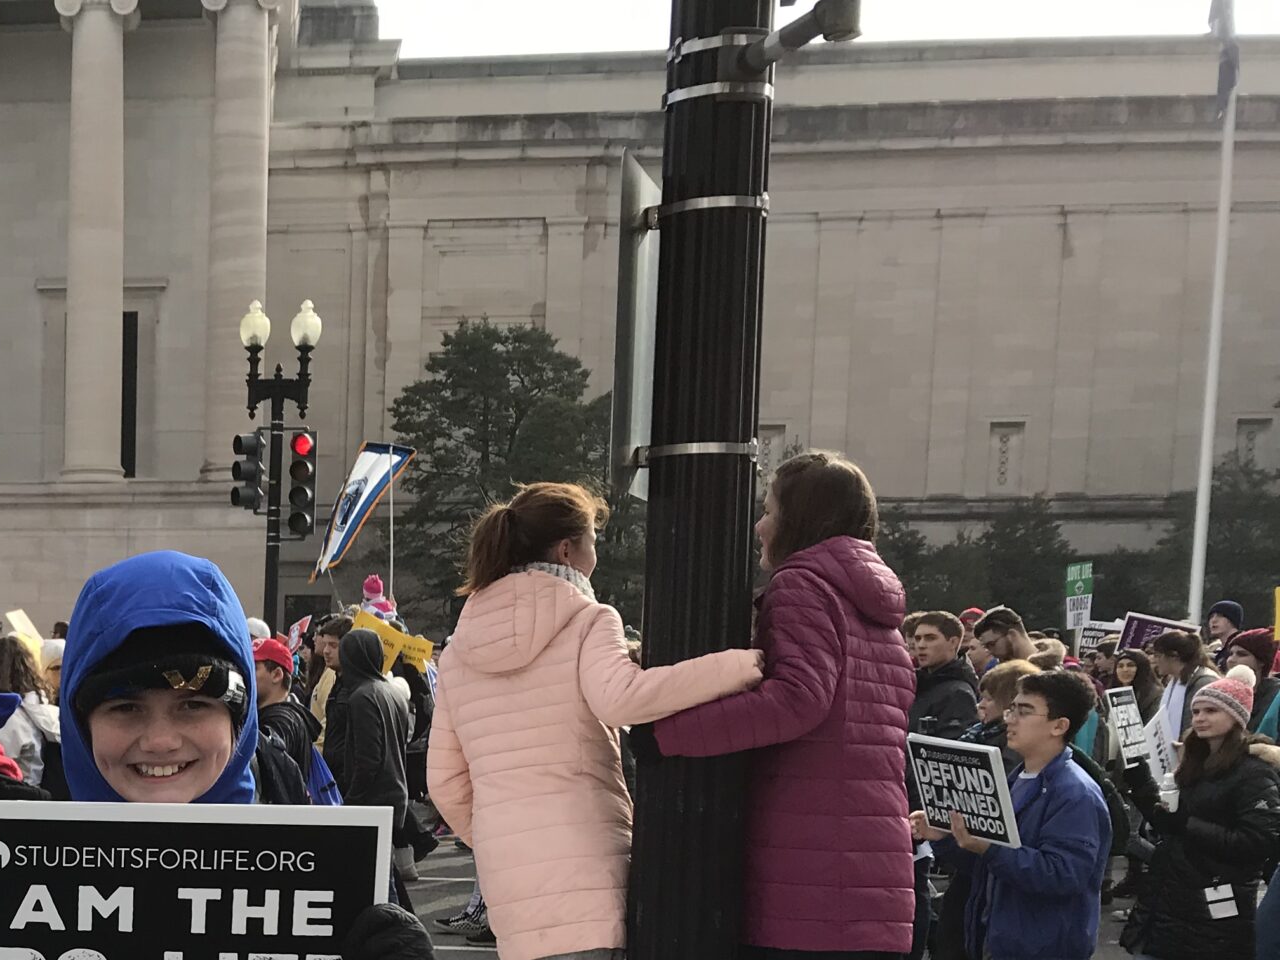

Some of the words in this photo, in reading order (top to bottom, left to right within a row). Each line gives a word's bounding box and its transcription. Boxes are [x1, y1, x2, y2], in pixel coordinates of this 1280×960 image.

[915, 758, 995, 795] DEFUND
[921, 783, 1000, 818] PLANNED
[927, 806, 1005, 835] PARTHOOD
[14, 845, 316, 872] STUDENTSFORLIFE.ORG
[9, 884, 135, 932] AM
[177, 888, 334, 937] THE
